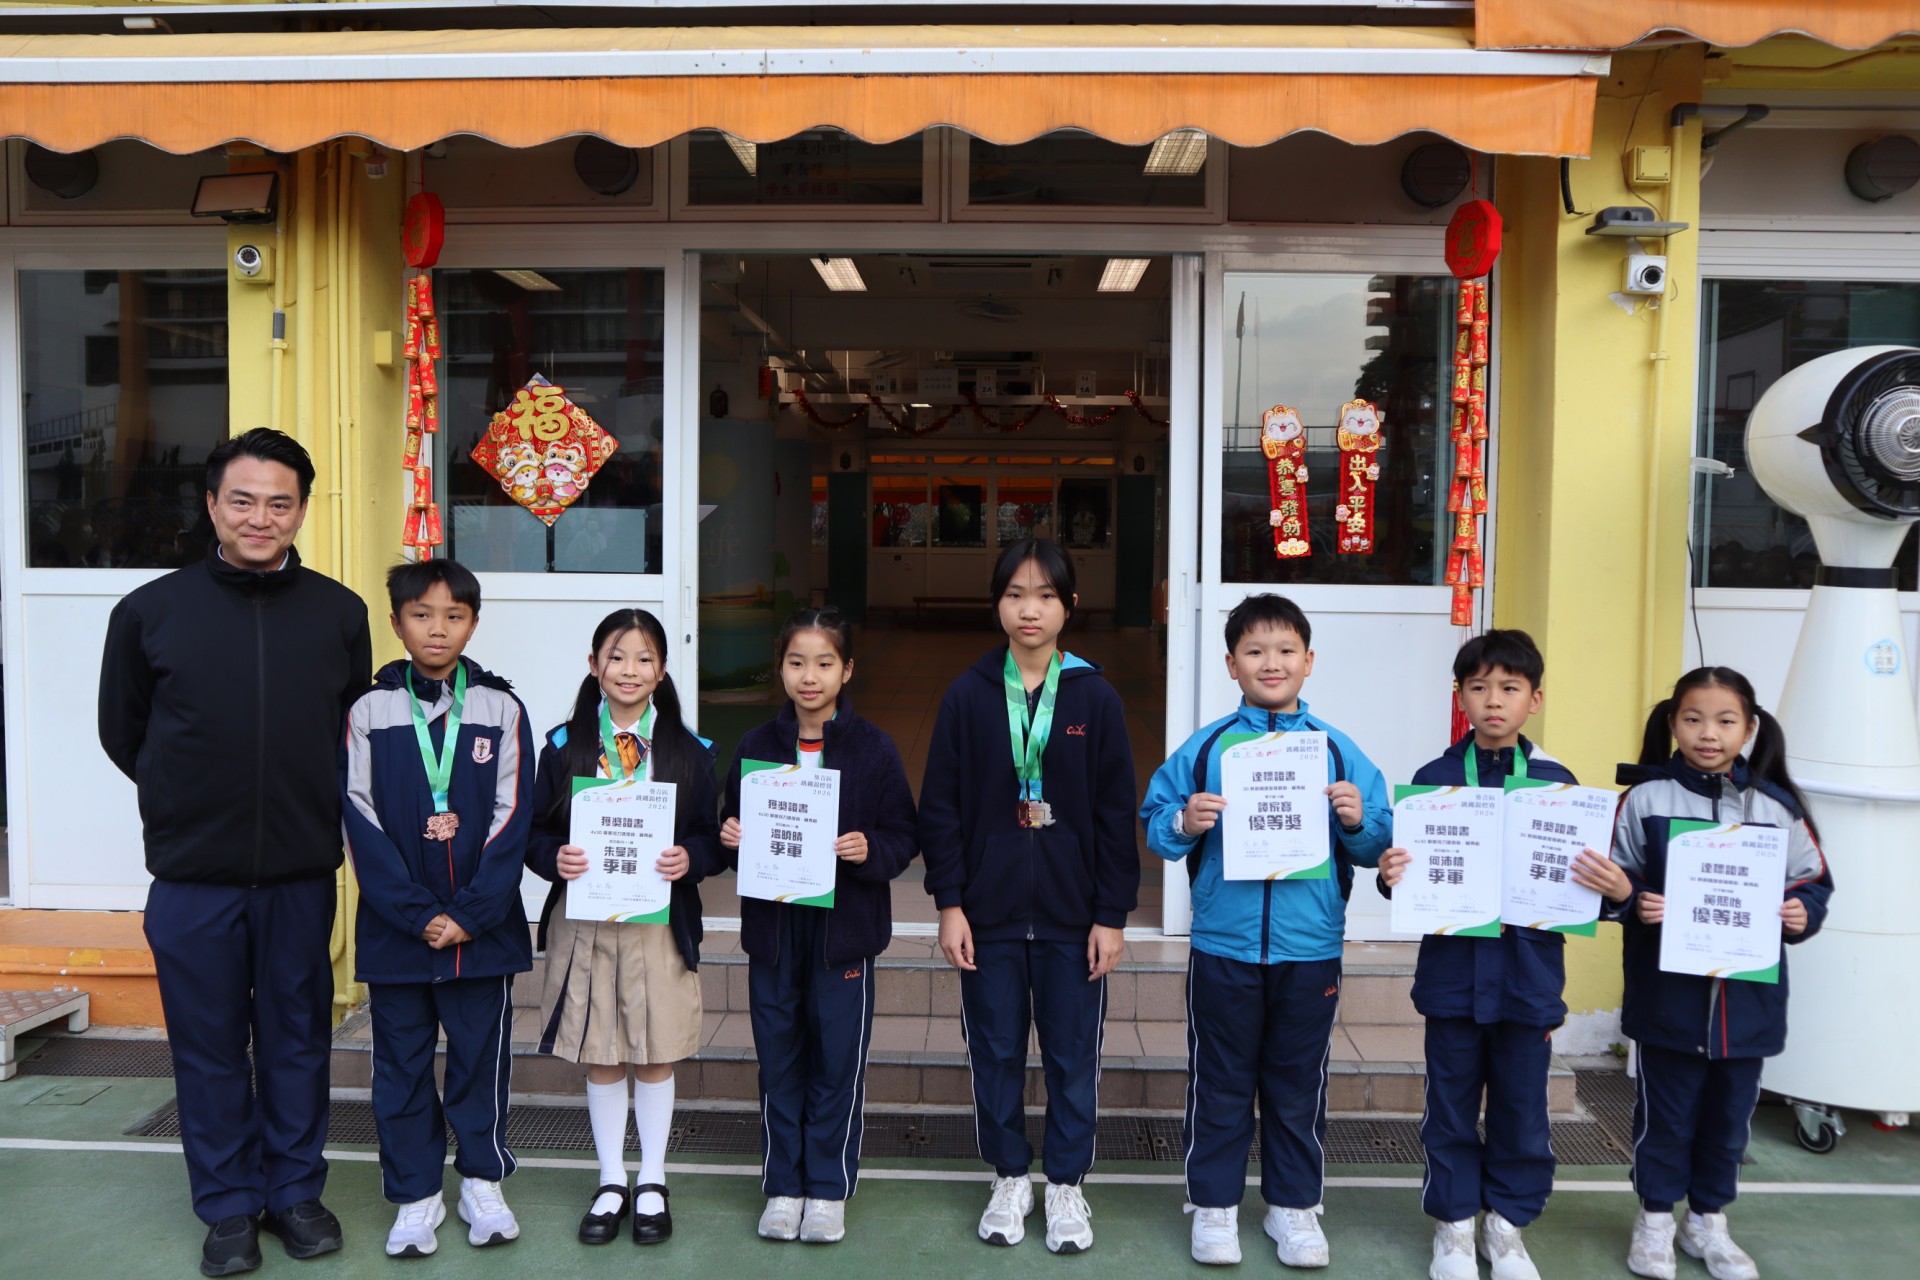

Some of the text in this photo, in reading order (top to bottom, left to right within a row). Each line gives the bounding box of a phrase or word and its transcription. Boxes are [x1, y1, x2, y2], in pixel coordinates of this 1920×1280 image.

[511, 385, 570, 441] 福
[1275, 458, 1301, 538] 恭喜發財
[1347, 454, 1368, 533] 出入平安
[767, 799, 808, 814] 獲獎證書
[601, 816, 644, 829] 獲獎證書
[1248, 814, 1302, 831] 優等獎
[770, 840, 803, 858] 季軍
[603, 858, 638, 875] 季軍
[1529, 863, 1567, 884] 季軍
[1428, 867, 1464, 885] 季軍
[1692, 906, 1751, 928] 優等獎
